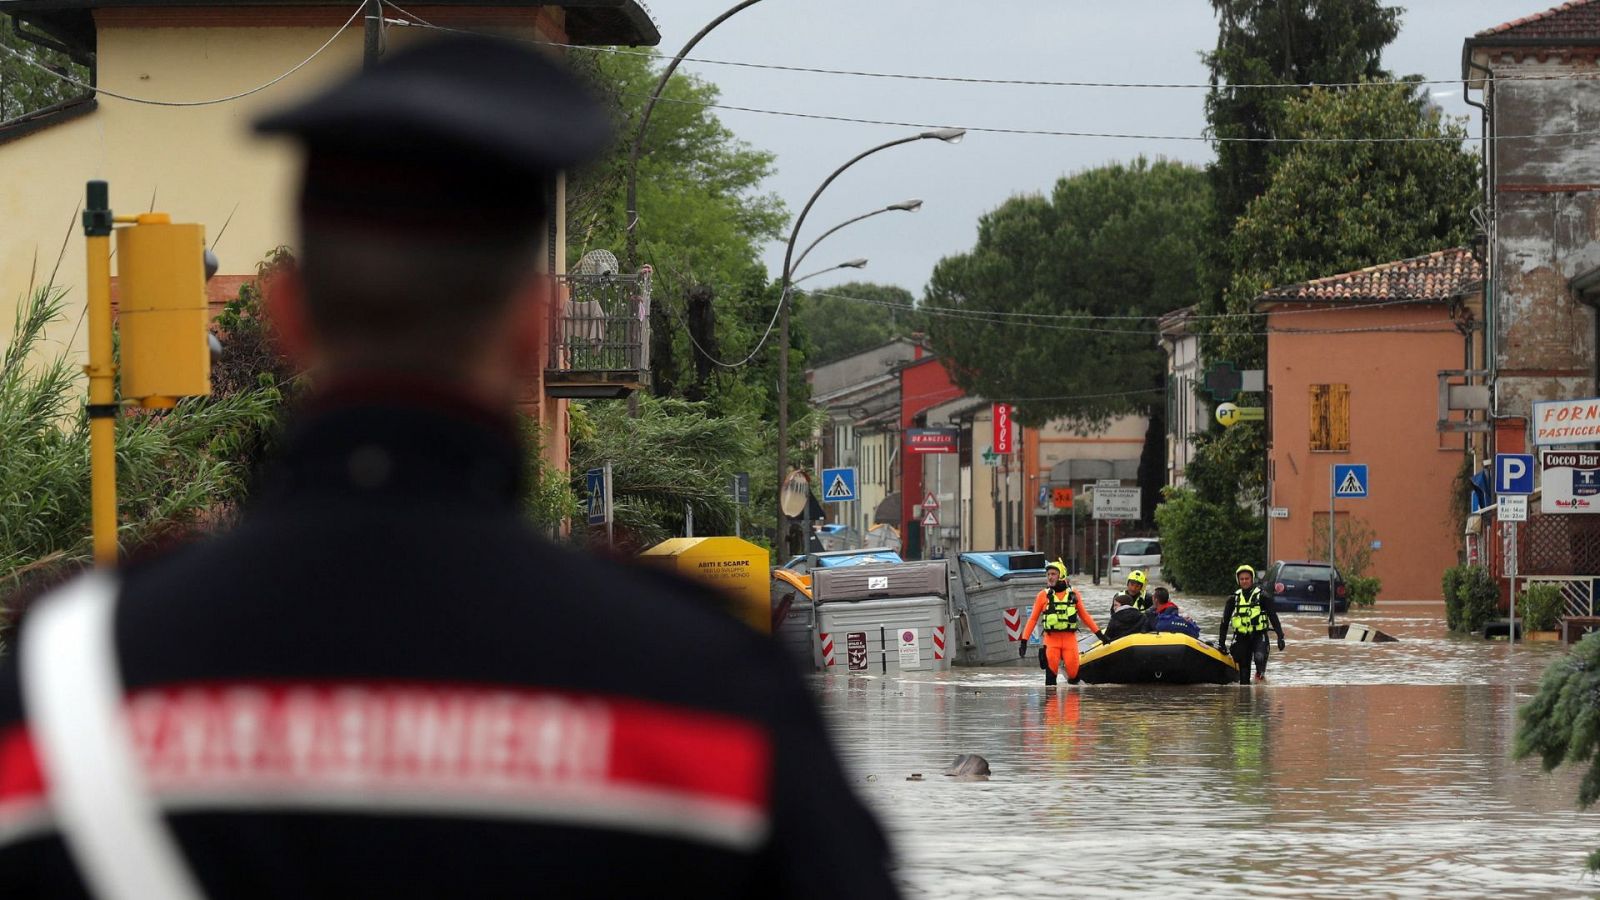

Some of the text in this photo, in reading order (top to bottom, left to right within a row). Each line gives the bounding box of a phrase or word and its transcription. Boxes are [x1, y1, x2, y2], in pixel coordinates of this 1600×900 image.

[1220, 409, 1235, 418] PT
[1544, 404, 1600, 422] FORN
[1546, 454, 1599, 466] Cocco Bar
[1503, 458, 1526, 490] P
